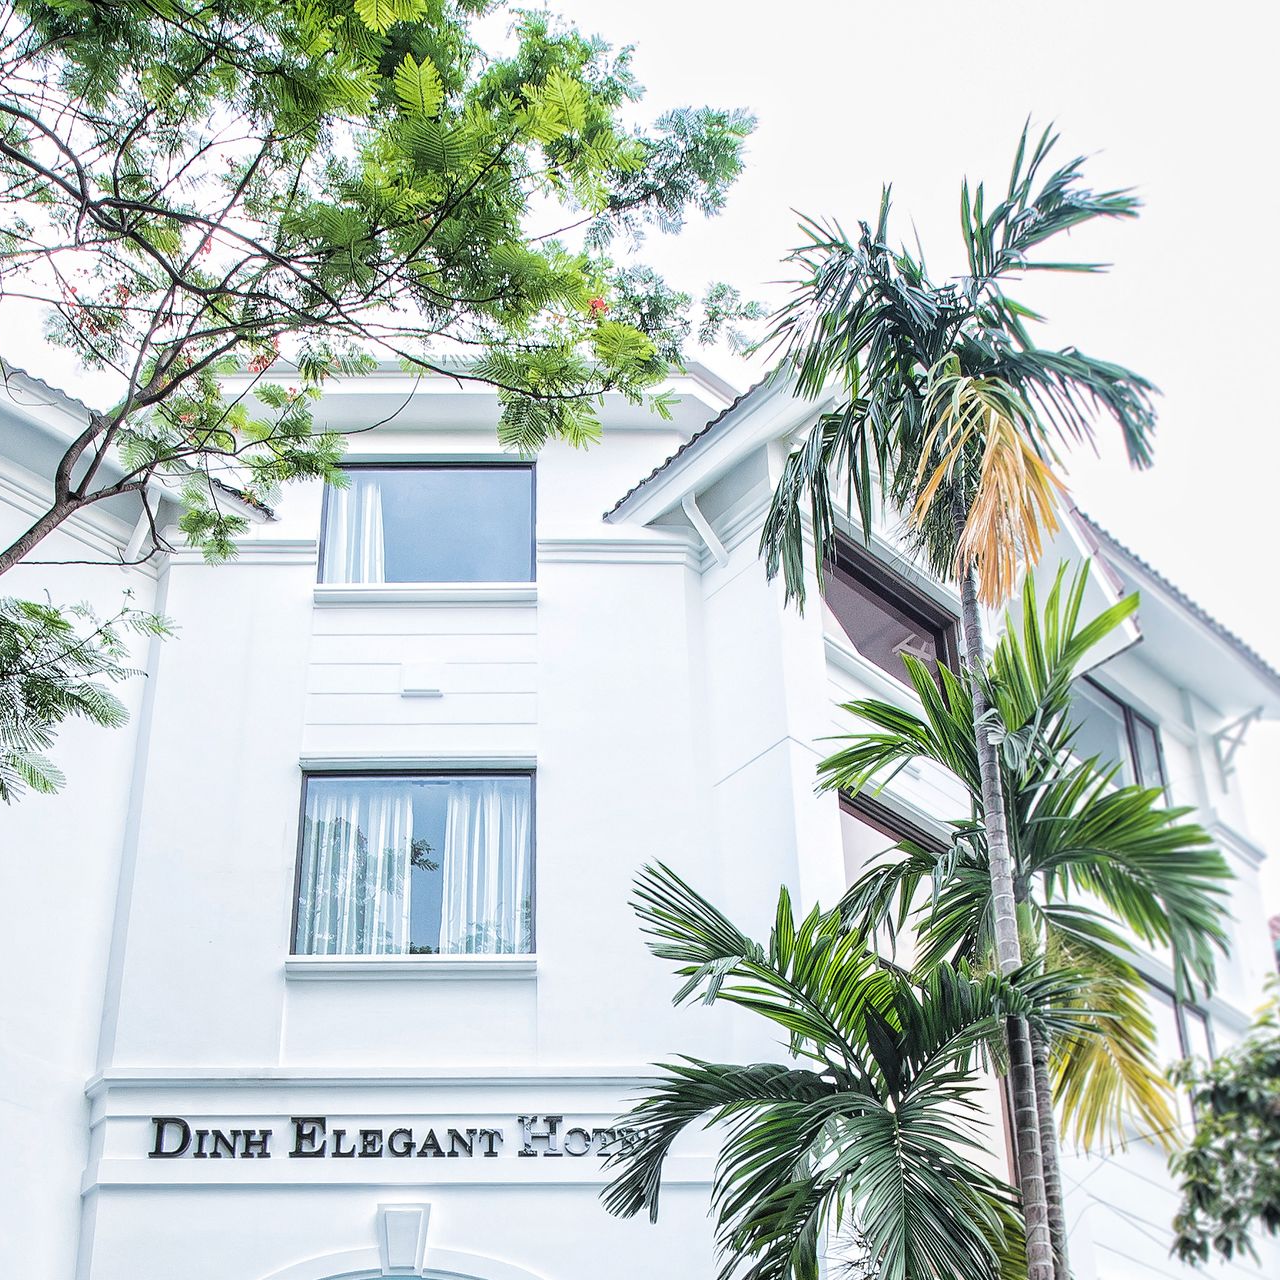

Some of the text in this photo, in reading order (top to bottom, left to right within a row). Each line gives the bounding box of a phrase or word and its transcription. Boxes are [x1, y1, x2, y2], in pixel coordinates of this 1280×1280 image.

[148, 1115, 668, 1159] DINH ELEGANT HOTE
